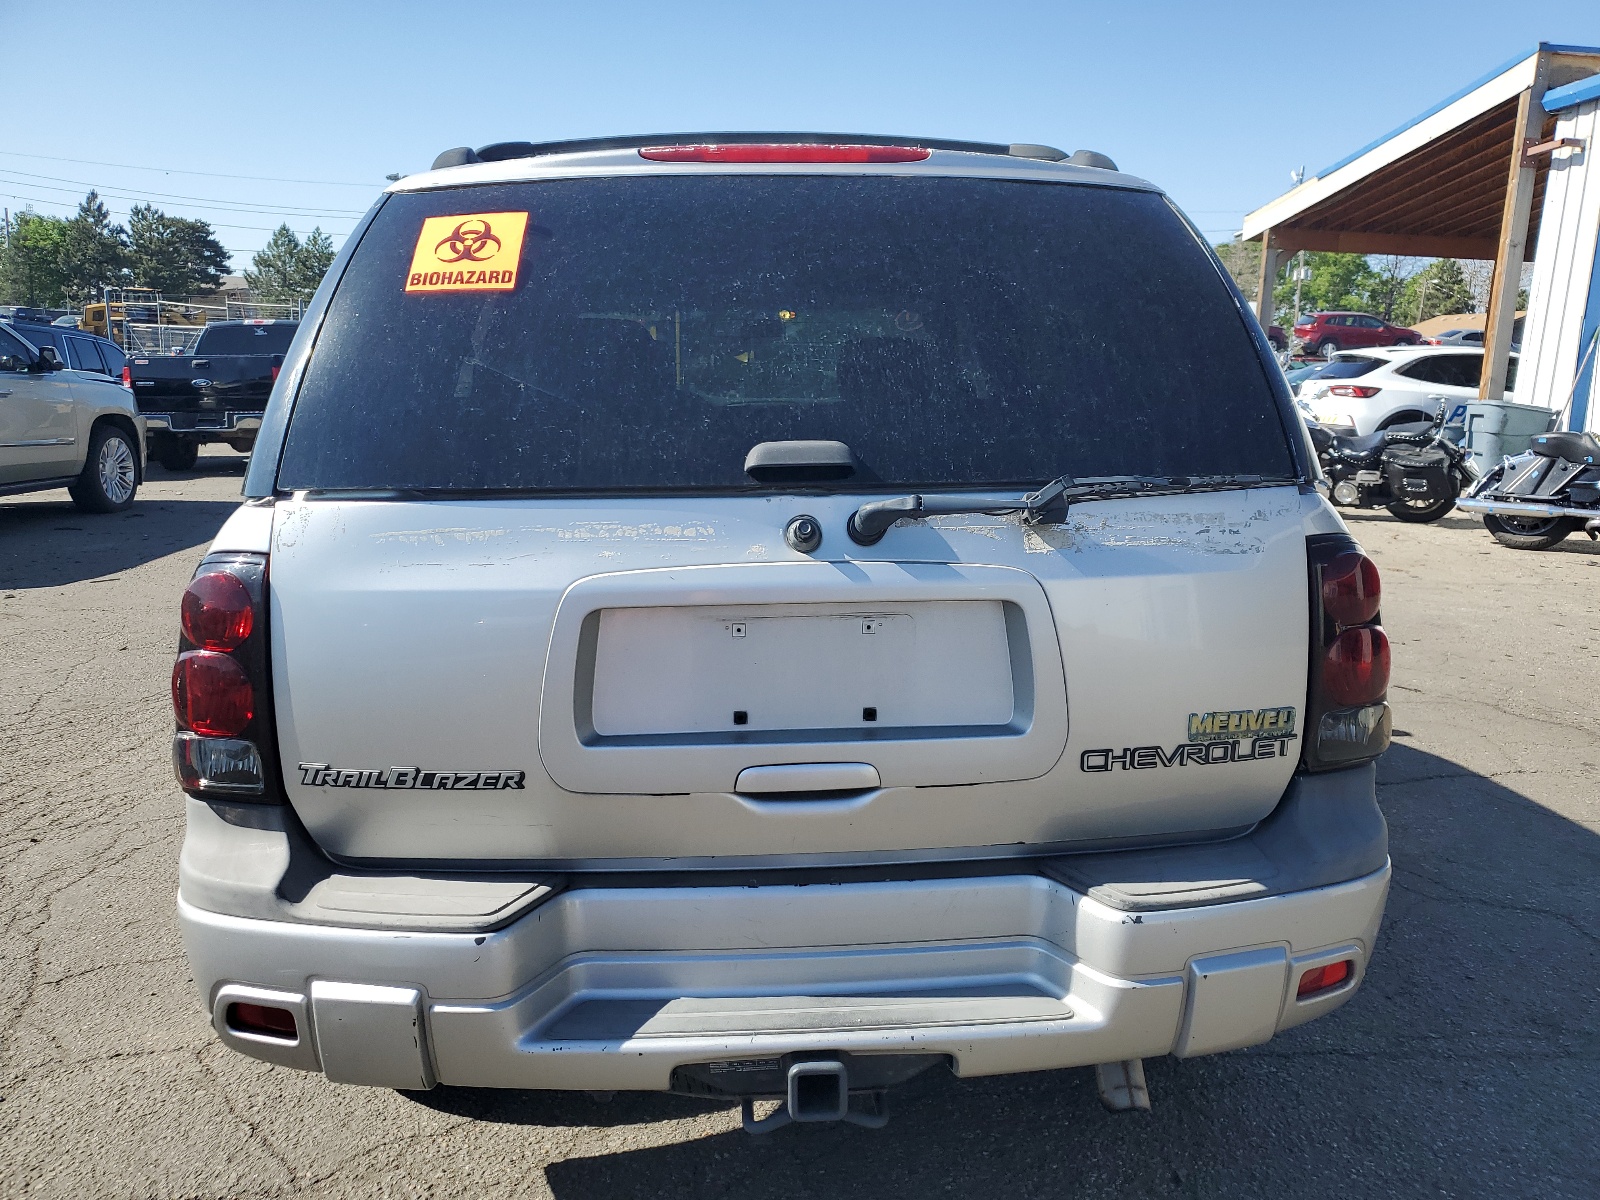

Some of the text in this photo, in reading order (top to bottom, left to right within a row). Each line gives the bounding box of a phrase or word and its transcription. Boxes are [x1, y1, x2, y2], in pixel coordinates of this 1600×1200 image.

[409, 270, 513, 286] BIOHAZARD
[1189, 707, 1296, 734] MEDVED
[1081, 734, 1297, 772] CHEVROLET
[298, 761, 526, 790] TRAILBLAZER
